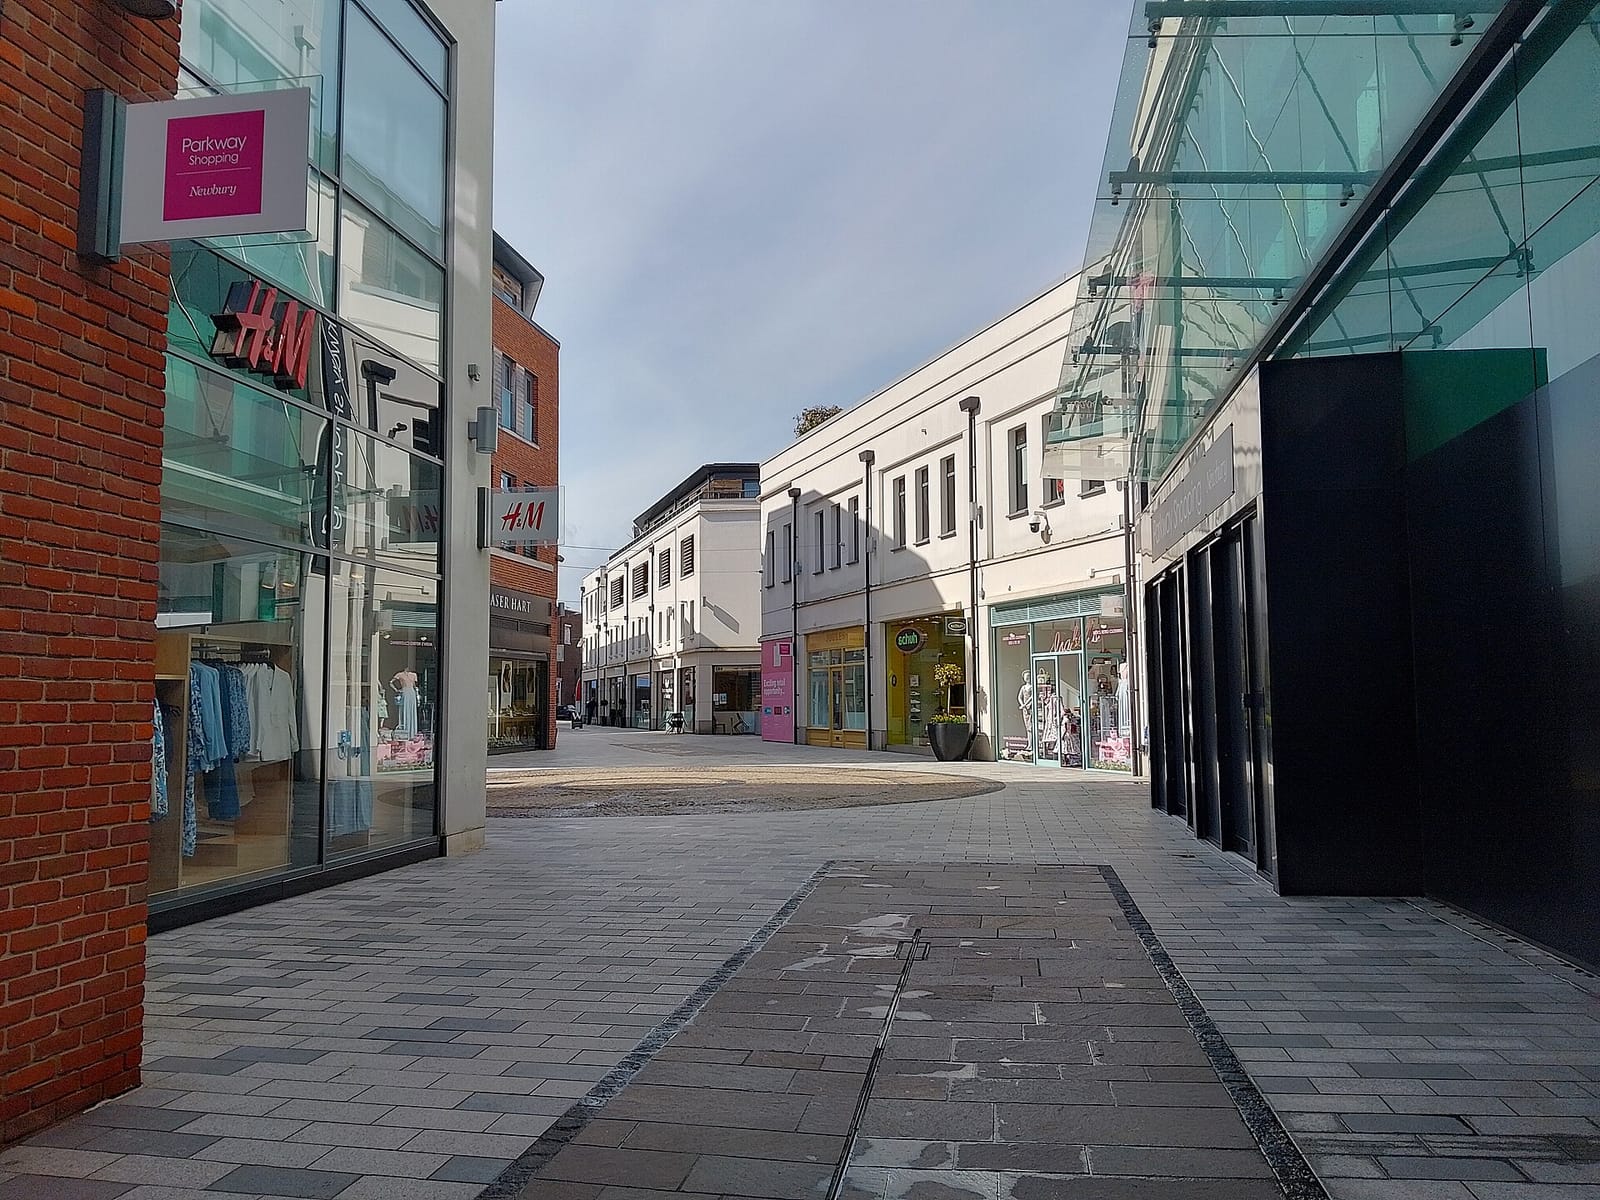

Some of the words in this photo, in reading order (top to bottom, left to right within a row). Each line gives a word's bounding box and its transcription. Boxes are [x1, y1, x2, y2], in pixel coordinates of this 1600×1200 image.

[182, 136, 247, 153] Parkway
[189, 152, 239, 166] Shopping
[189, 184, 237, 197] Newbury
[234, 279, 317, 389] H&M
[500, 501, 545, 531] H&M
[511, 597, 531, 613] HART
[898, 632, 918, 646] schuh
